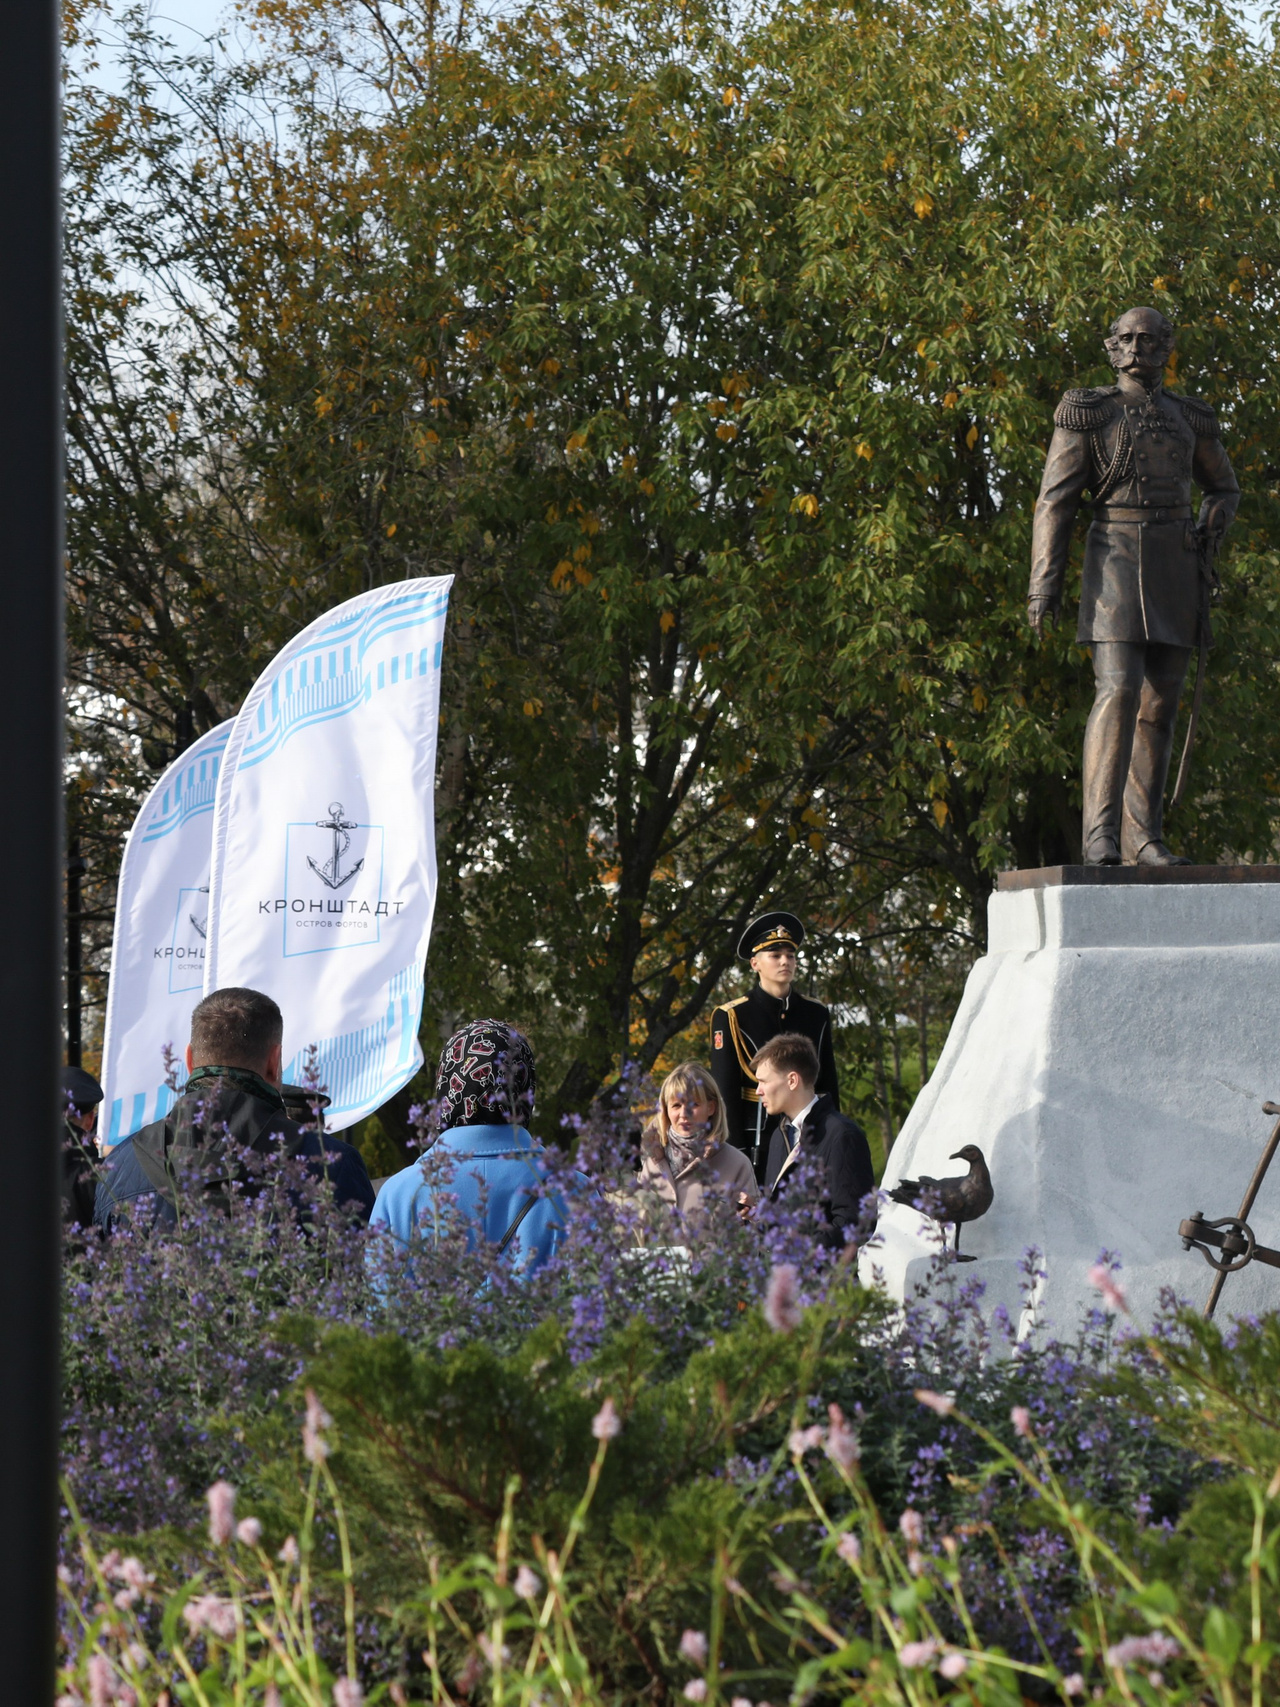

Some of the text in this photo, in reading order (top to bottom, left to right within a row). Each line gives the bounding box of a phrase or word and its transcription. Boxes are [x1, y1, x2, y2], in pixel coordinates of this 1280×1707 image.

[258, 898, 404, 917] КРОНШТАДТ
[295, 920, 368, 929] ОСТРОВ ФОРТОВ
